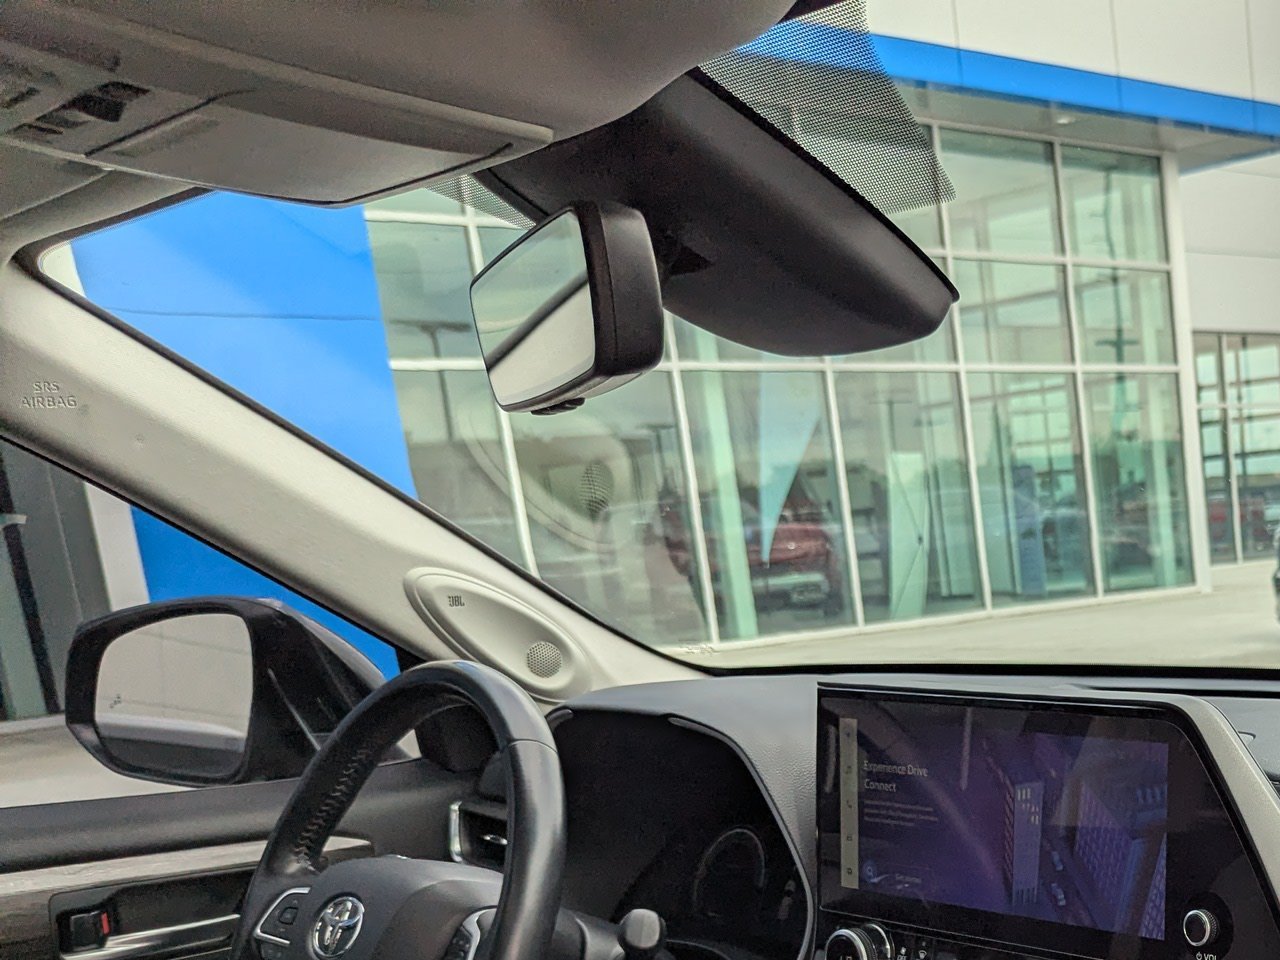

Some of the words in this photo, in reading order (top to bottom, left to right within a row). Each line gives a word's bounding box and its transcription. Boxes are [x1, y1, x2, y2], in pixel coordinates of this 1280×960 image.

[33, 381, 60, 393] SRS
[20, 395, 79, 409] AIRBAG
[448, 595, 465, 607] JBL
[863, 760, 907, 776] Experience
[907, 764, 929, 777] Drive
[864, 779, 896, 792] Connect
